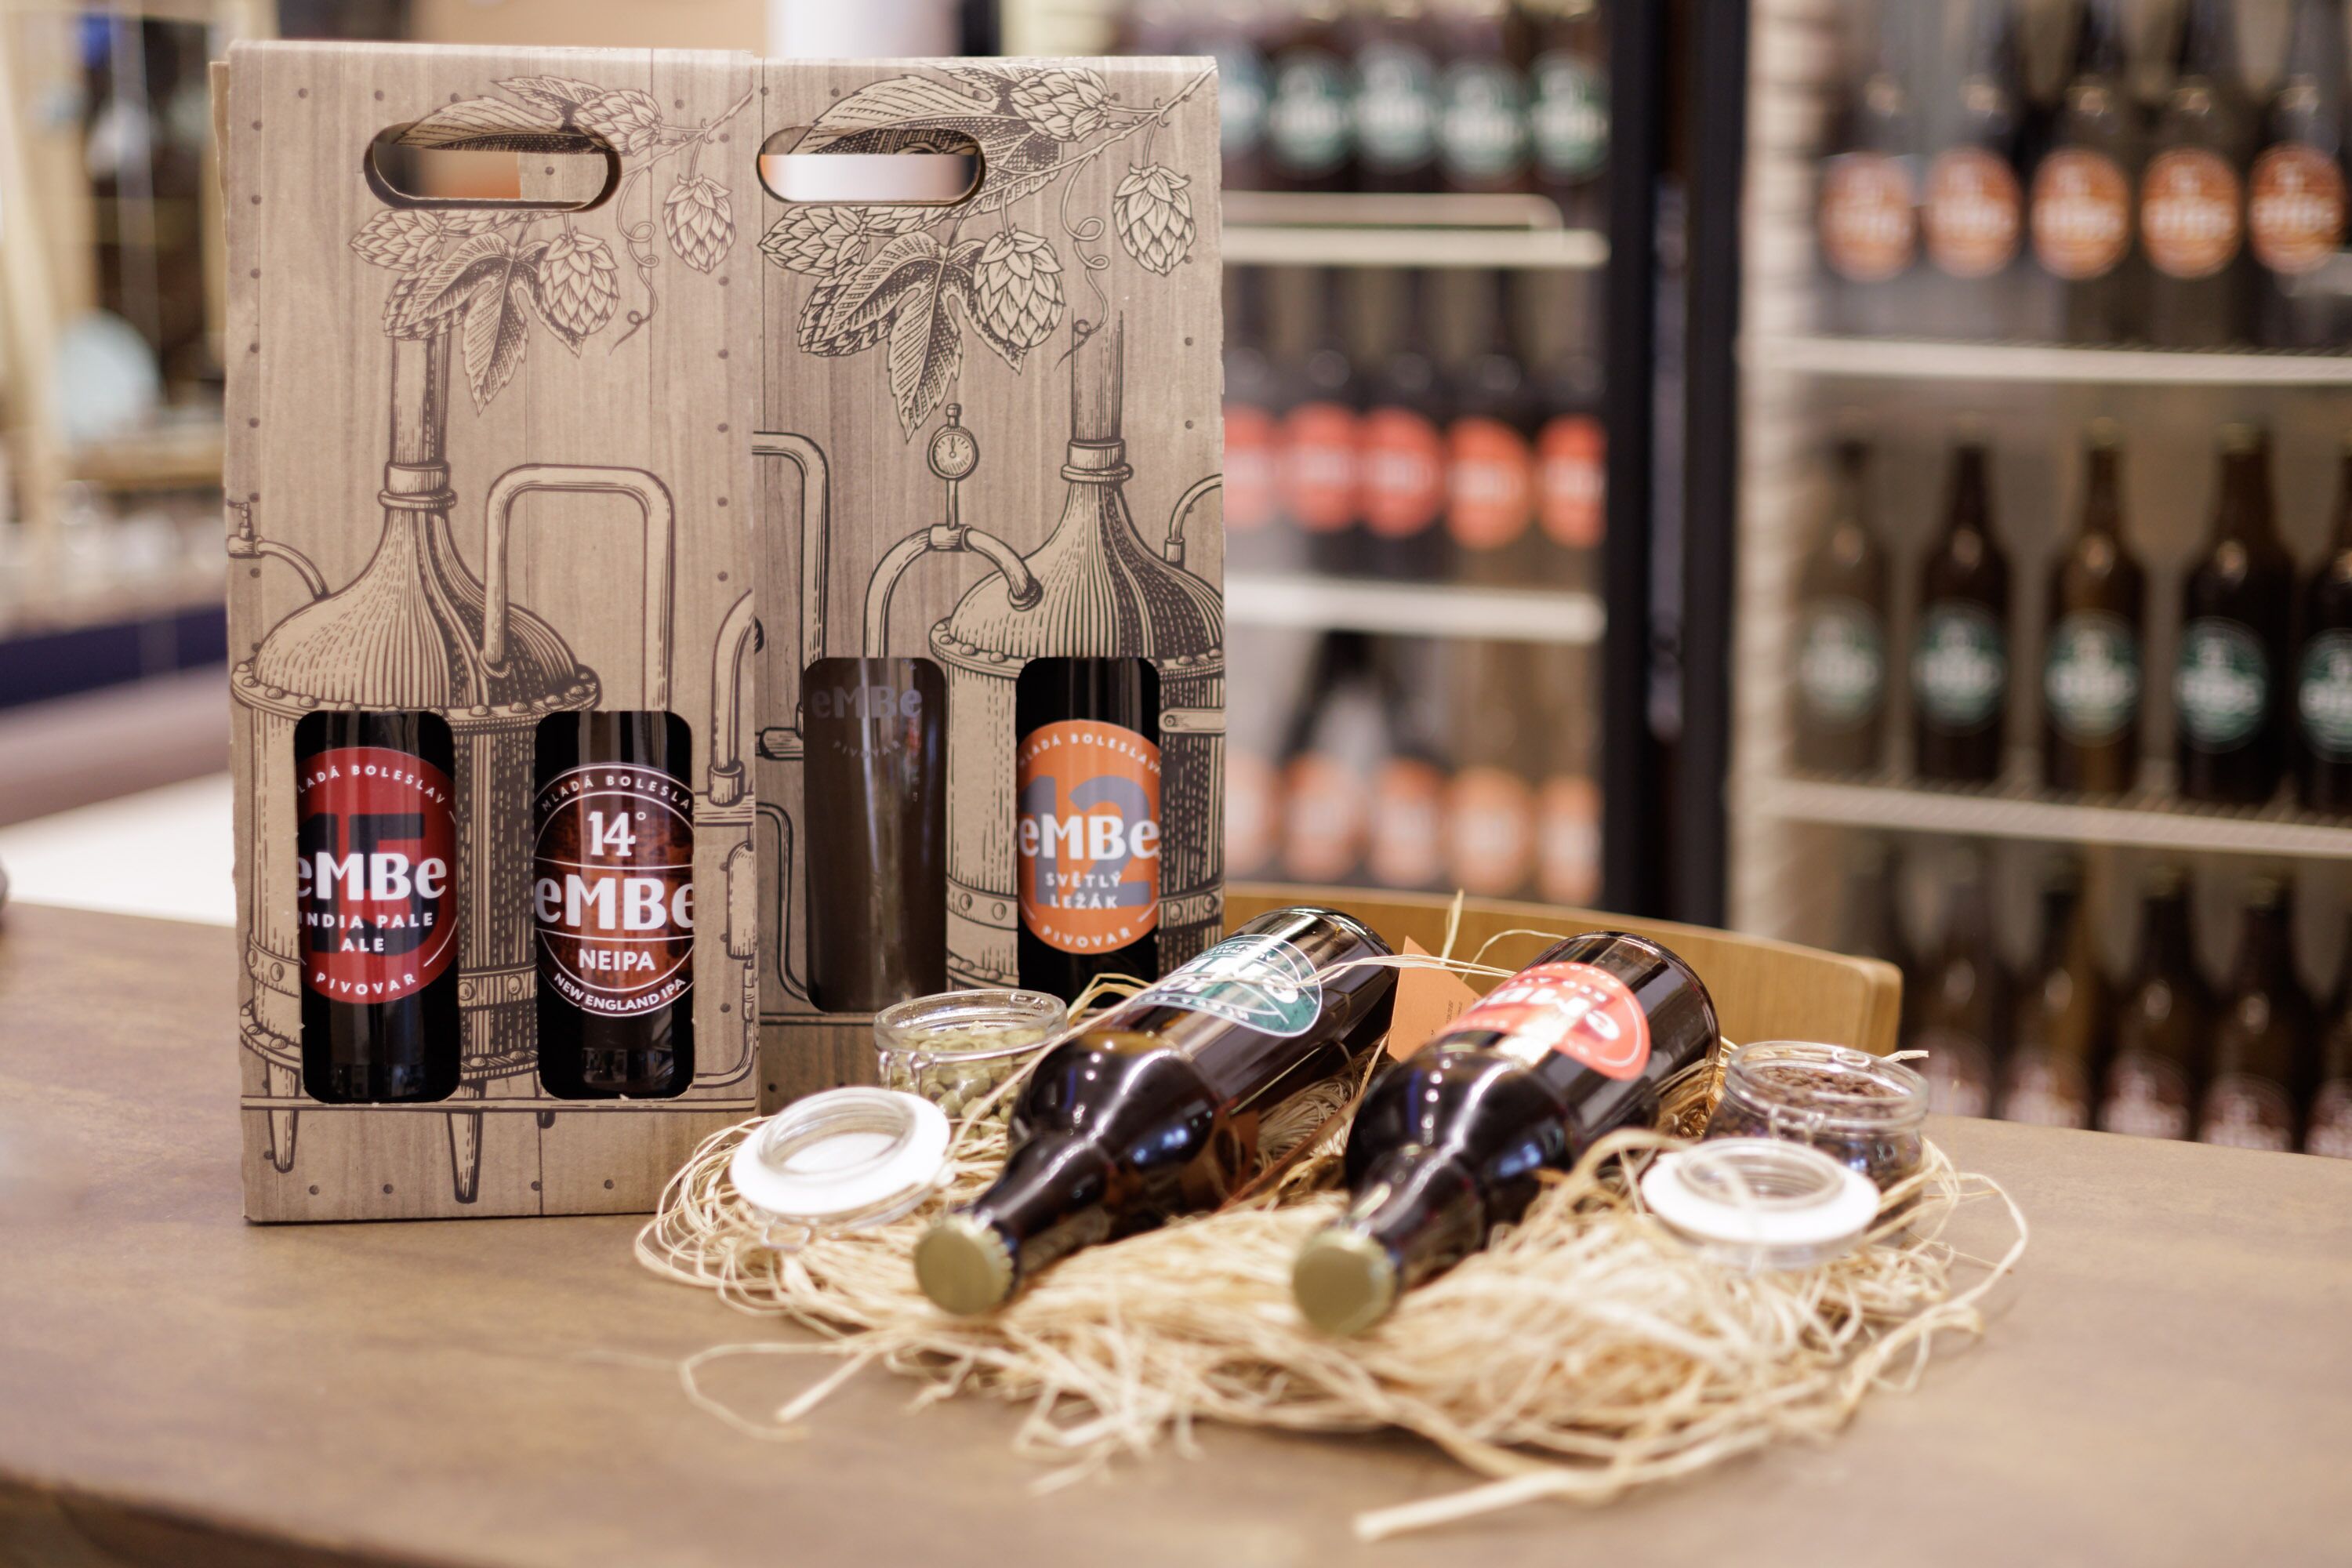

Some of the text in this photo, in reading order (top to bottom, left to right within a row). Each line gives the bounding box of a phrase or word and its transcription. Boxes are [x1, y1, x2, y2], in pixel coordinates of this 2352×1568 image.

[811, 686, 922, 718] eMBe
[298, 764, 445, 804] LADÁ BOLESLAV
[542, 775, 690, 812] MLADÁ BOLESLA
[1020, 813, 1160, 860] eMBe
[1045, 869, 1122, 888] SVĚTLÝ
[535, 873, 695, 931] eMBe
[1050, 892, 1118, 909] LEŽÁK
[376, 912, 434, 929] PALE
[341, 938, 385, 952] ALE
[1042, 924, 1131, 948] PIVOVAR
[578, 948, 656, 972] NEIPA
[316, 971, 416, 995] PIVOVAR
[554, 973, 687, 1011] NEW ENGLAND IPA
